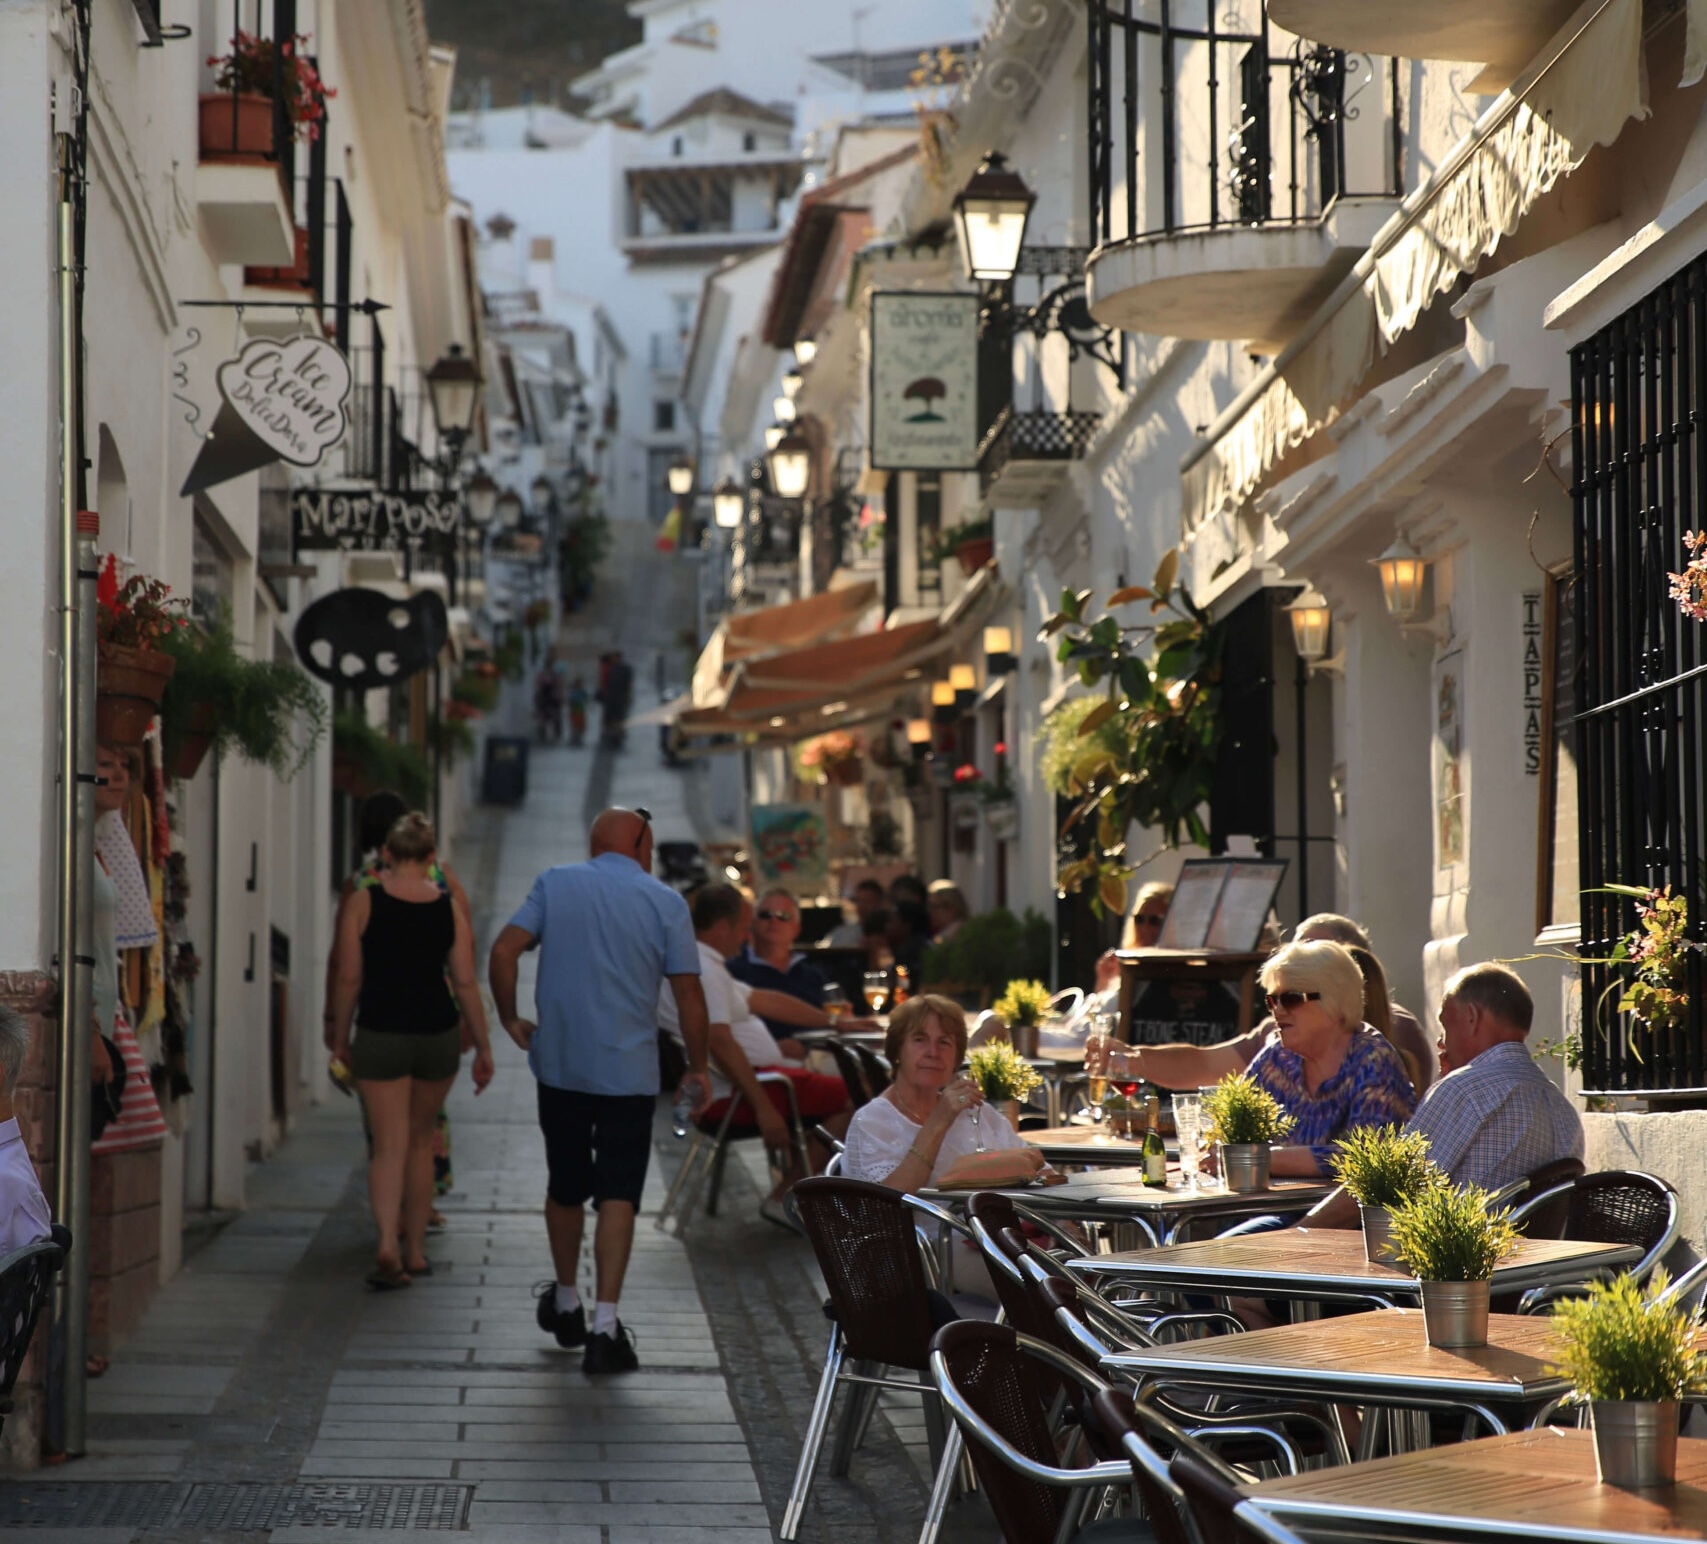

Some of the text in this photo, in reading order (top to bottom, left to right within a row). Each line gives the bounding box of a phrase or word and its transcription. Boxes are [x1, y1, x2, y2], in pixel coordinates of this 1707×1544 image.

[245, 351, 335, 433] Cream
[293, 346, 330, 390] Ice
[1523, 598, 1540, 772] TAPAS
